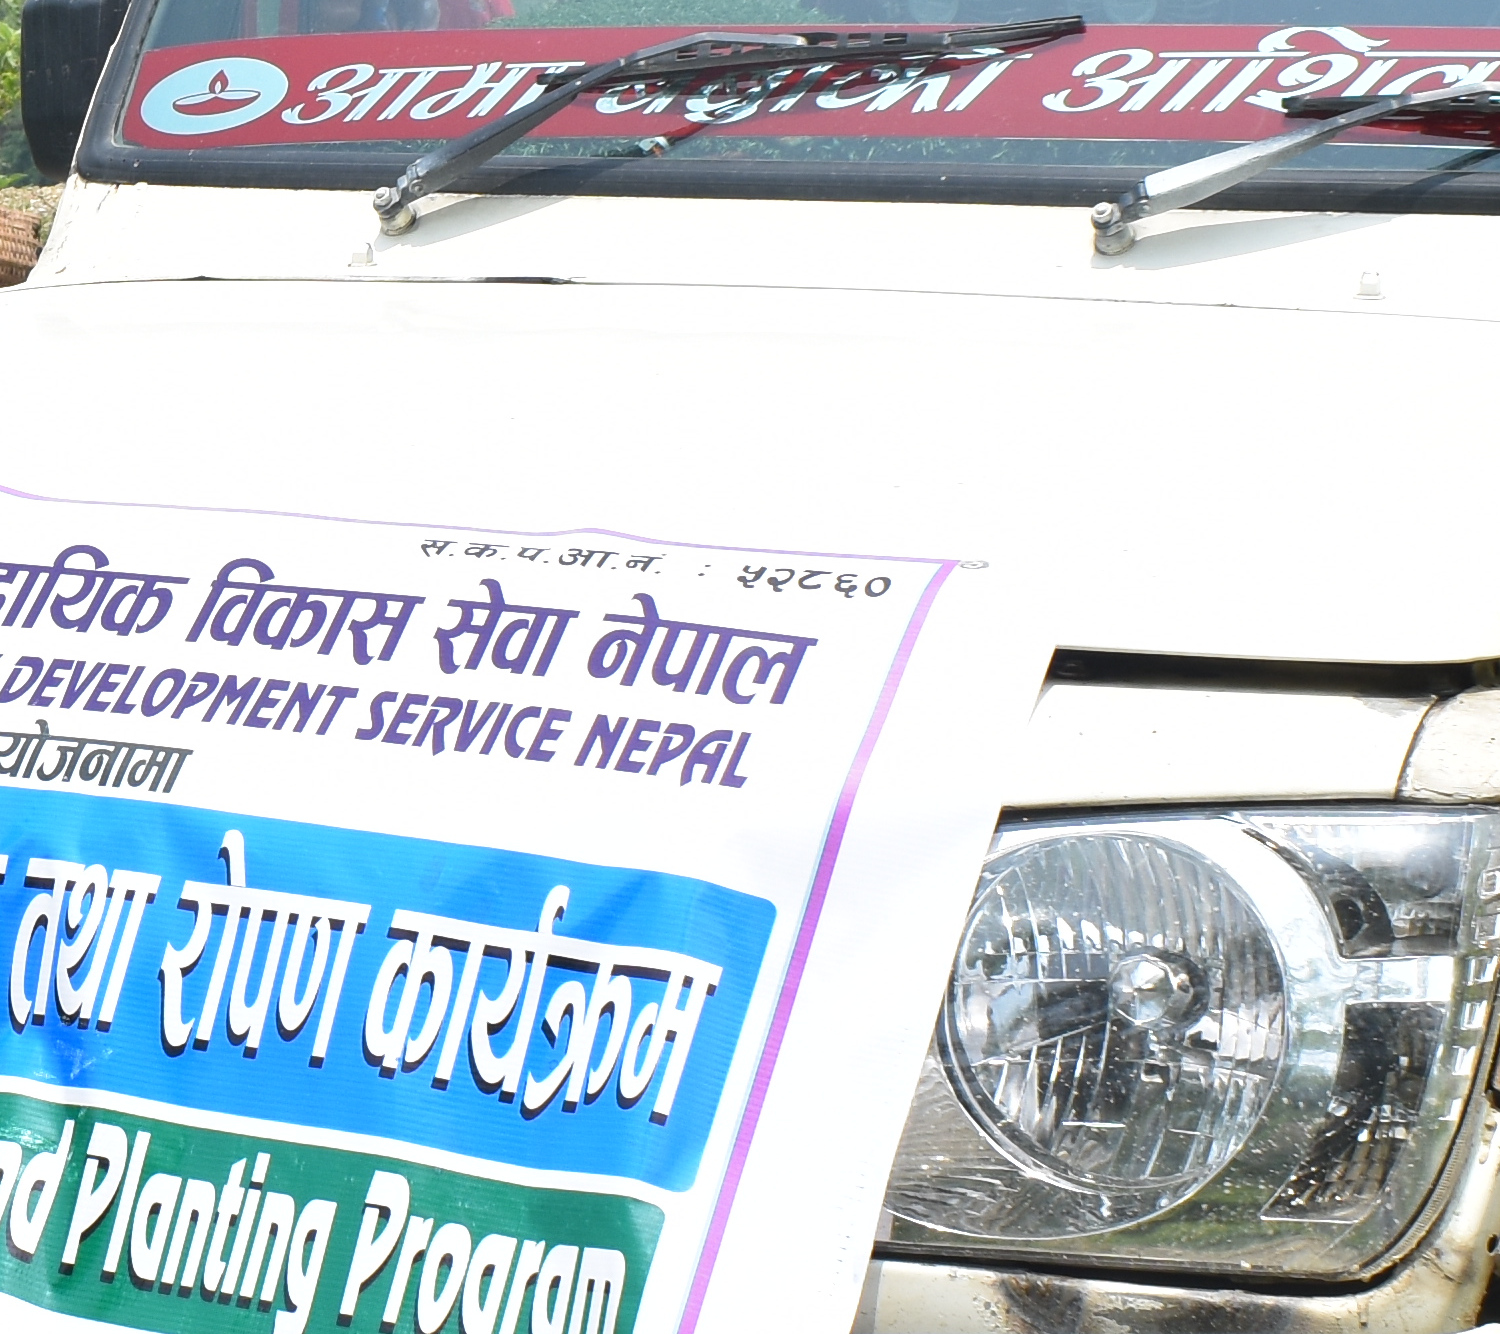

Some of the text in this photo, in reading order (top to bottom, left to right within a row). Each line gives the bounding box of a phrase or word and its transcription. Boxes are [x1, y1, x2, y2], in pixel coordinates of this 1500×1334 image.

[185, 557, 425, 665] विकास
[434, 578, 579, 675] सेवा
[587, 592, 818, 705] नेपाल
[737, 563, 892, 599] ५२८६०
[355, 690, 572, 762] SERVICE
[573, 713, 753, 789] NEPAL
[8, 857, 162, 1032] तथा
[158, 829, 372, 1068] रोपण
[361, 884, 724, 1126] कार्यक्रम
